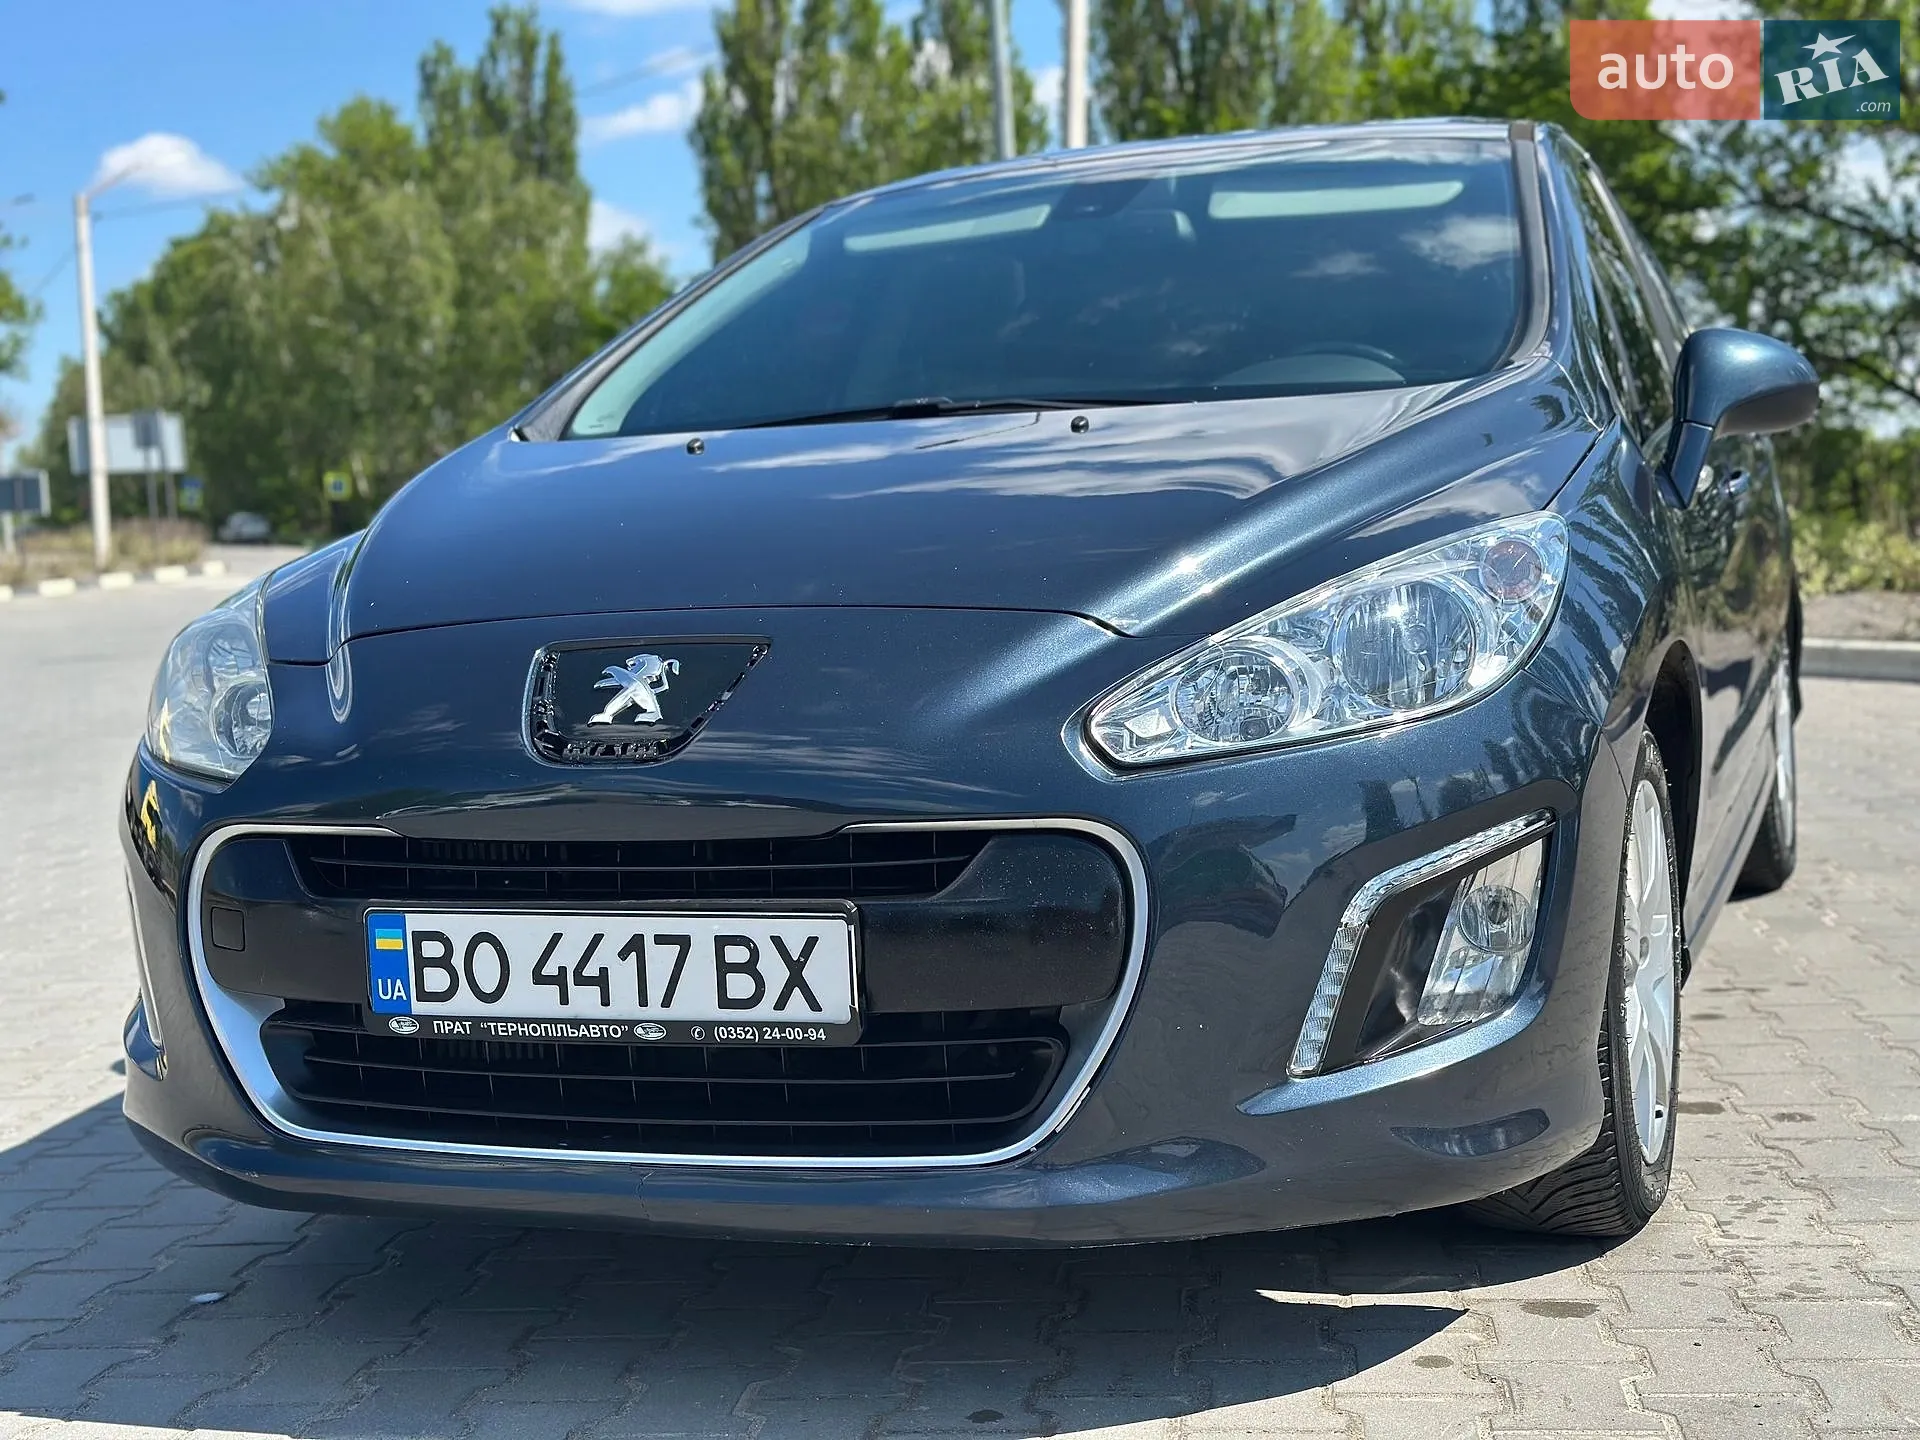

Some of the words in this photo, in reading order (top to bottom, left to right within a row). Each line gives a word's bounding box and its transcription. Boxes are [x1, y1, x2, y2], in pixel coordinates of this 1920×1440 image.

[411, 930, 511, 1004] BO
[532, 932, 692, 1008] 4417
[714, 935, 823, 1012] BX
[377, 978, 408, 1001] UA
[433, 1020, 472, 1035] ПРАТ
[714, 1026, 759, 1042] (0352)
[764, 1027, 827, 1041] 24-00-94
